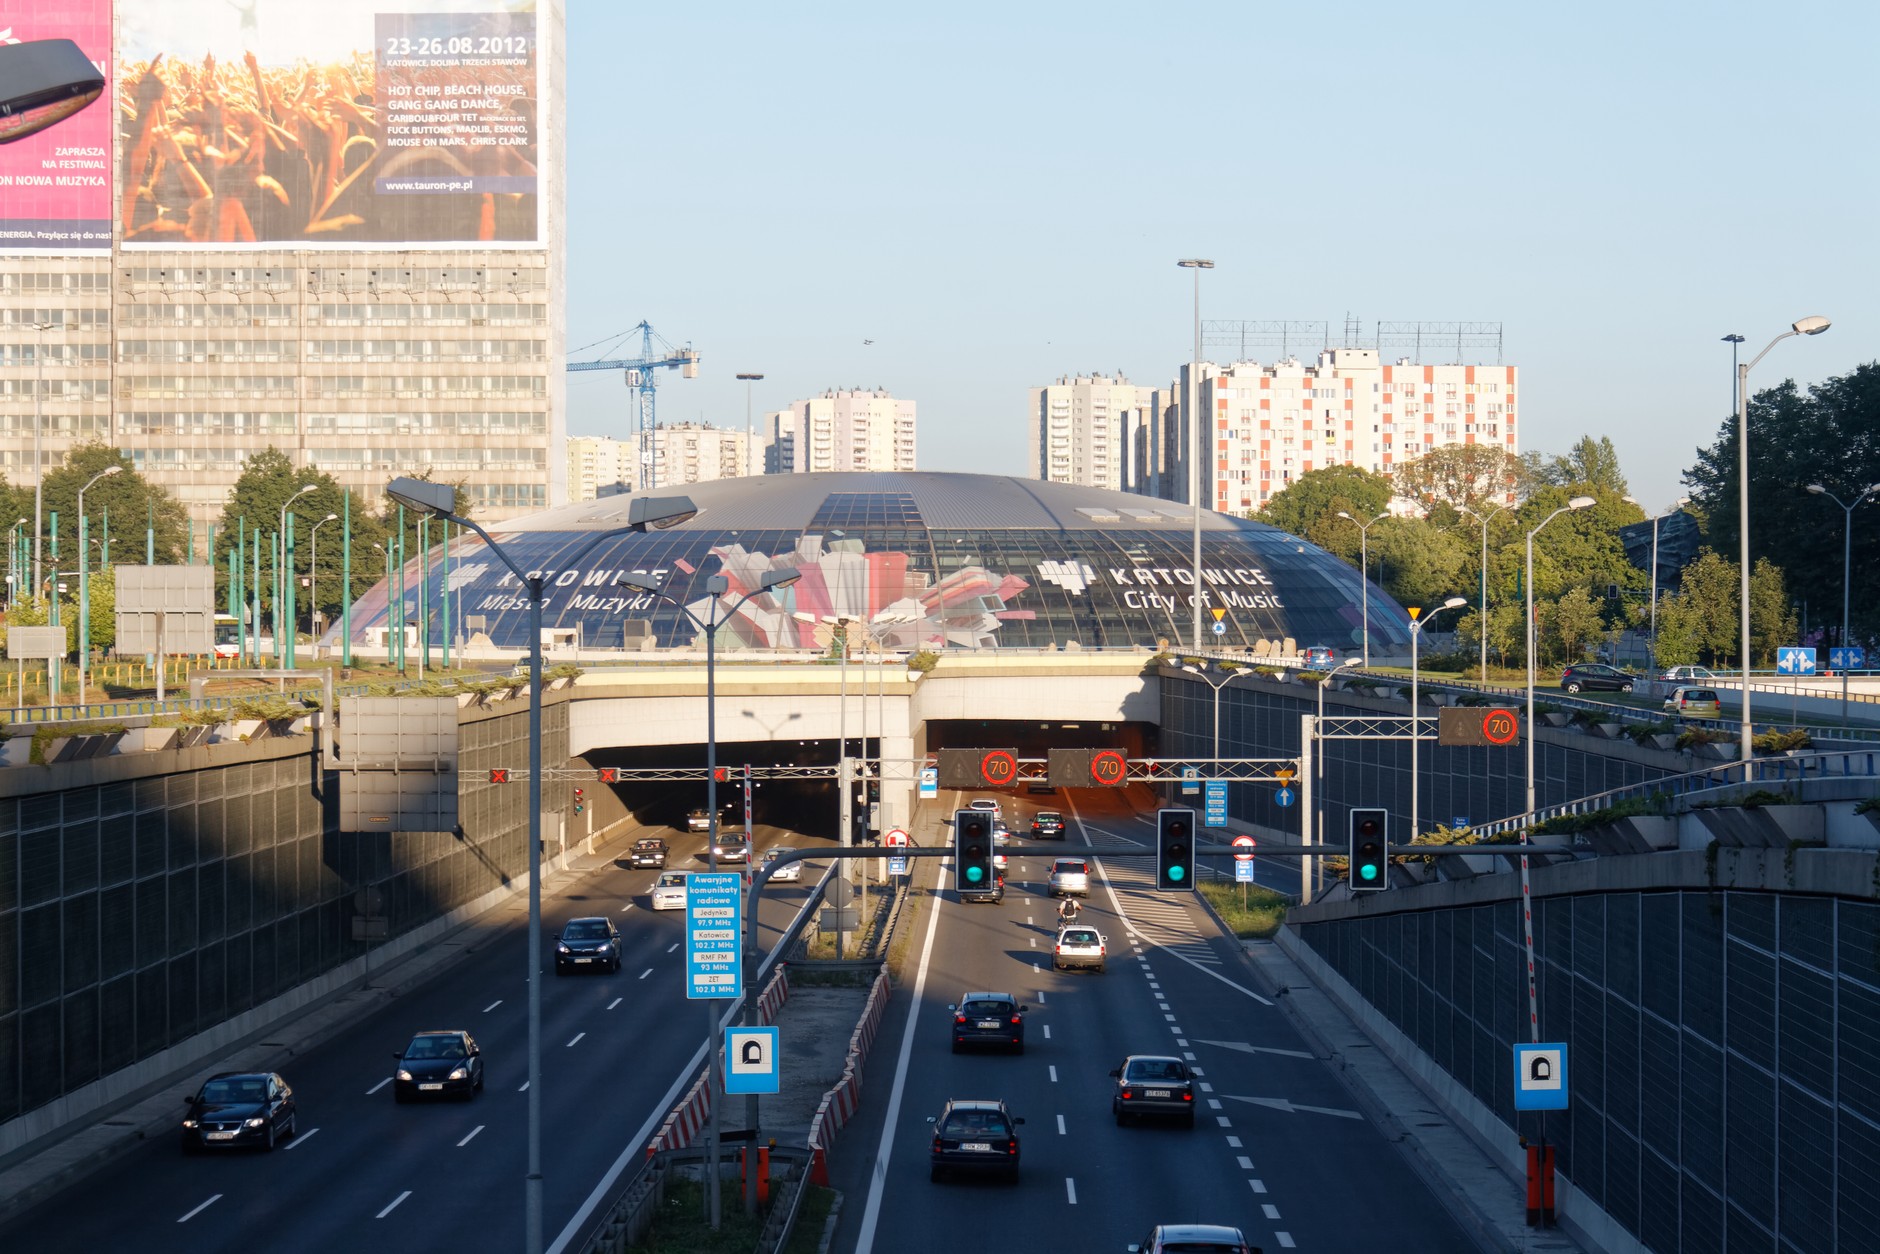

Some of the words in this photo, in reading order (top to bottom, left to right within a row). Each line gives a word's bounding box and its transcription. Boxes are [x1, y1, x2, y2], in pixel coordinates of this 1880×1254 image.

[387, 36, 526, 55] 23-26.08.2012
[387, 59, 429, 67] KATOWICE,
[431, 59, 460, 67] DOLINA
[462, 58, 490, 66] TRZECH
[492, 57, 528, 66] STAWÓW
[388, 86, 412, 96] HOT
[415, 86, 441, 97] CHIP,
[444, 85, 481, 96] BEACH
[485, 85, 526, 96] HOUSE,
[388, 100, 421, 110] GANG
[425, 100, 458, 110] GANG
[461, 99, 503, 110] DANCE,
[387, 113, 460, 123] CARIBOU&FOUR
[462, 113, 478, 122] TET
[387, 126, 410, 135] FUCK
[412, 126, 455, 135] BUTTONS,
[456, 125, 492, 135] MADLIB,
[494, 125, 528, 134] ESKMO,
[387, 138, 421, 147] MOUSE
[423, 138, 437, 147] ON
[439, 137, 468, 147] MARS,
[470, 137, 496, 146] CHRIS
[499, 137, 528, 146] CLARK
[55, 147, 106, 156] ZAPRASZA
[42, 160, 57, 169] NA
[59, 160, 106, 169] FESTIWAL
[16, 175, 53, 186] NOWA
[56, 175, 106, 186] MUZYKA
[386, 180, 473, 191] www.tauron-pe.pl
[0, 231, 36, 239] ENERGIA.
[70, 231, 82, 241] się
[83, 231, 94, 239] do
[95, 231, 112, 240] nas!
[1109, 568, 1273, 585] KATOWICE
[567, 594, 655, 614] Muzyki
[1124, 590, 1175, 614] City
[1187, 590, 1211, 608] of
[1219, 590, 1285, 609] Music
[1492, 719, 1510, 734] 70
[990, 761, 1009, 775] 70
[1100, 761, 1118, 775] 70
[694, 876, 733, 886] Awaryjne
[689, 886, 738, 895] komunikaty
[697, 897, 731, 905] radiowe
[700, 909, 728, 917] Jedynka
[697, 919, 713, 927] 97.9
[715, 919, 731, 927] MHz
[699, 931, 730, 939] Katowice
[713, 963, 729, 971] MHz
